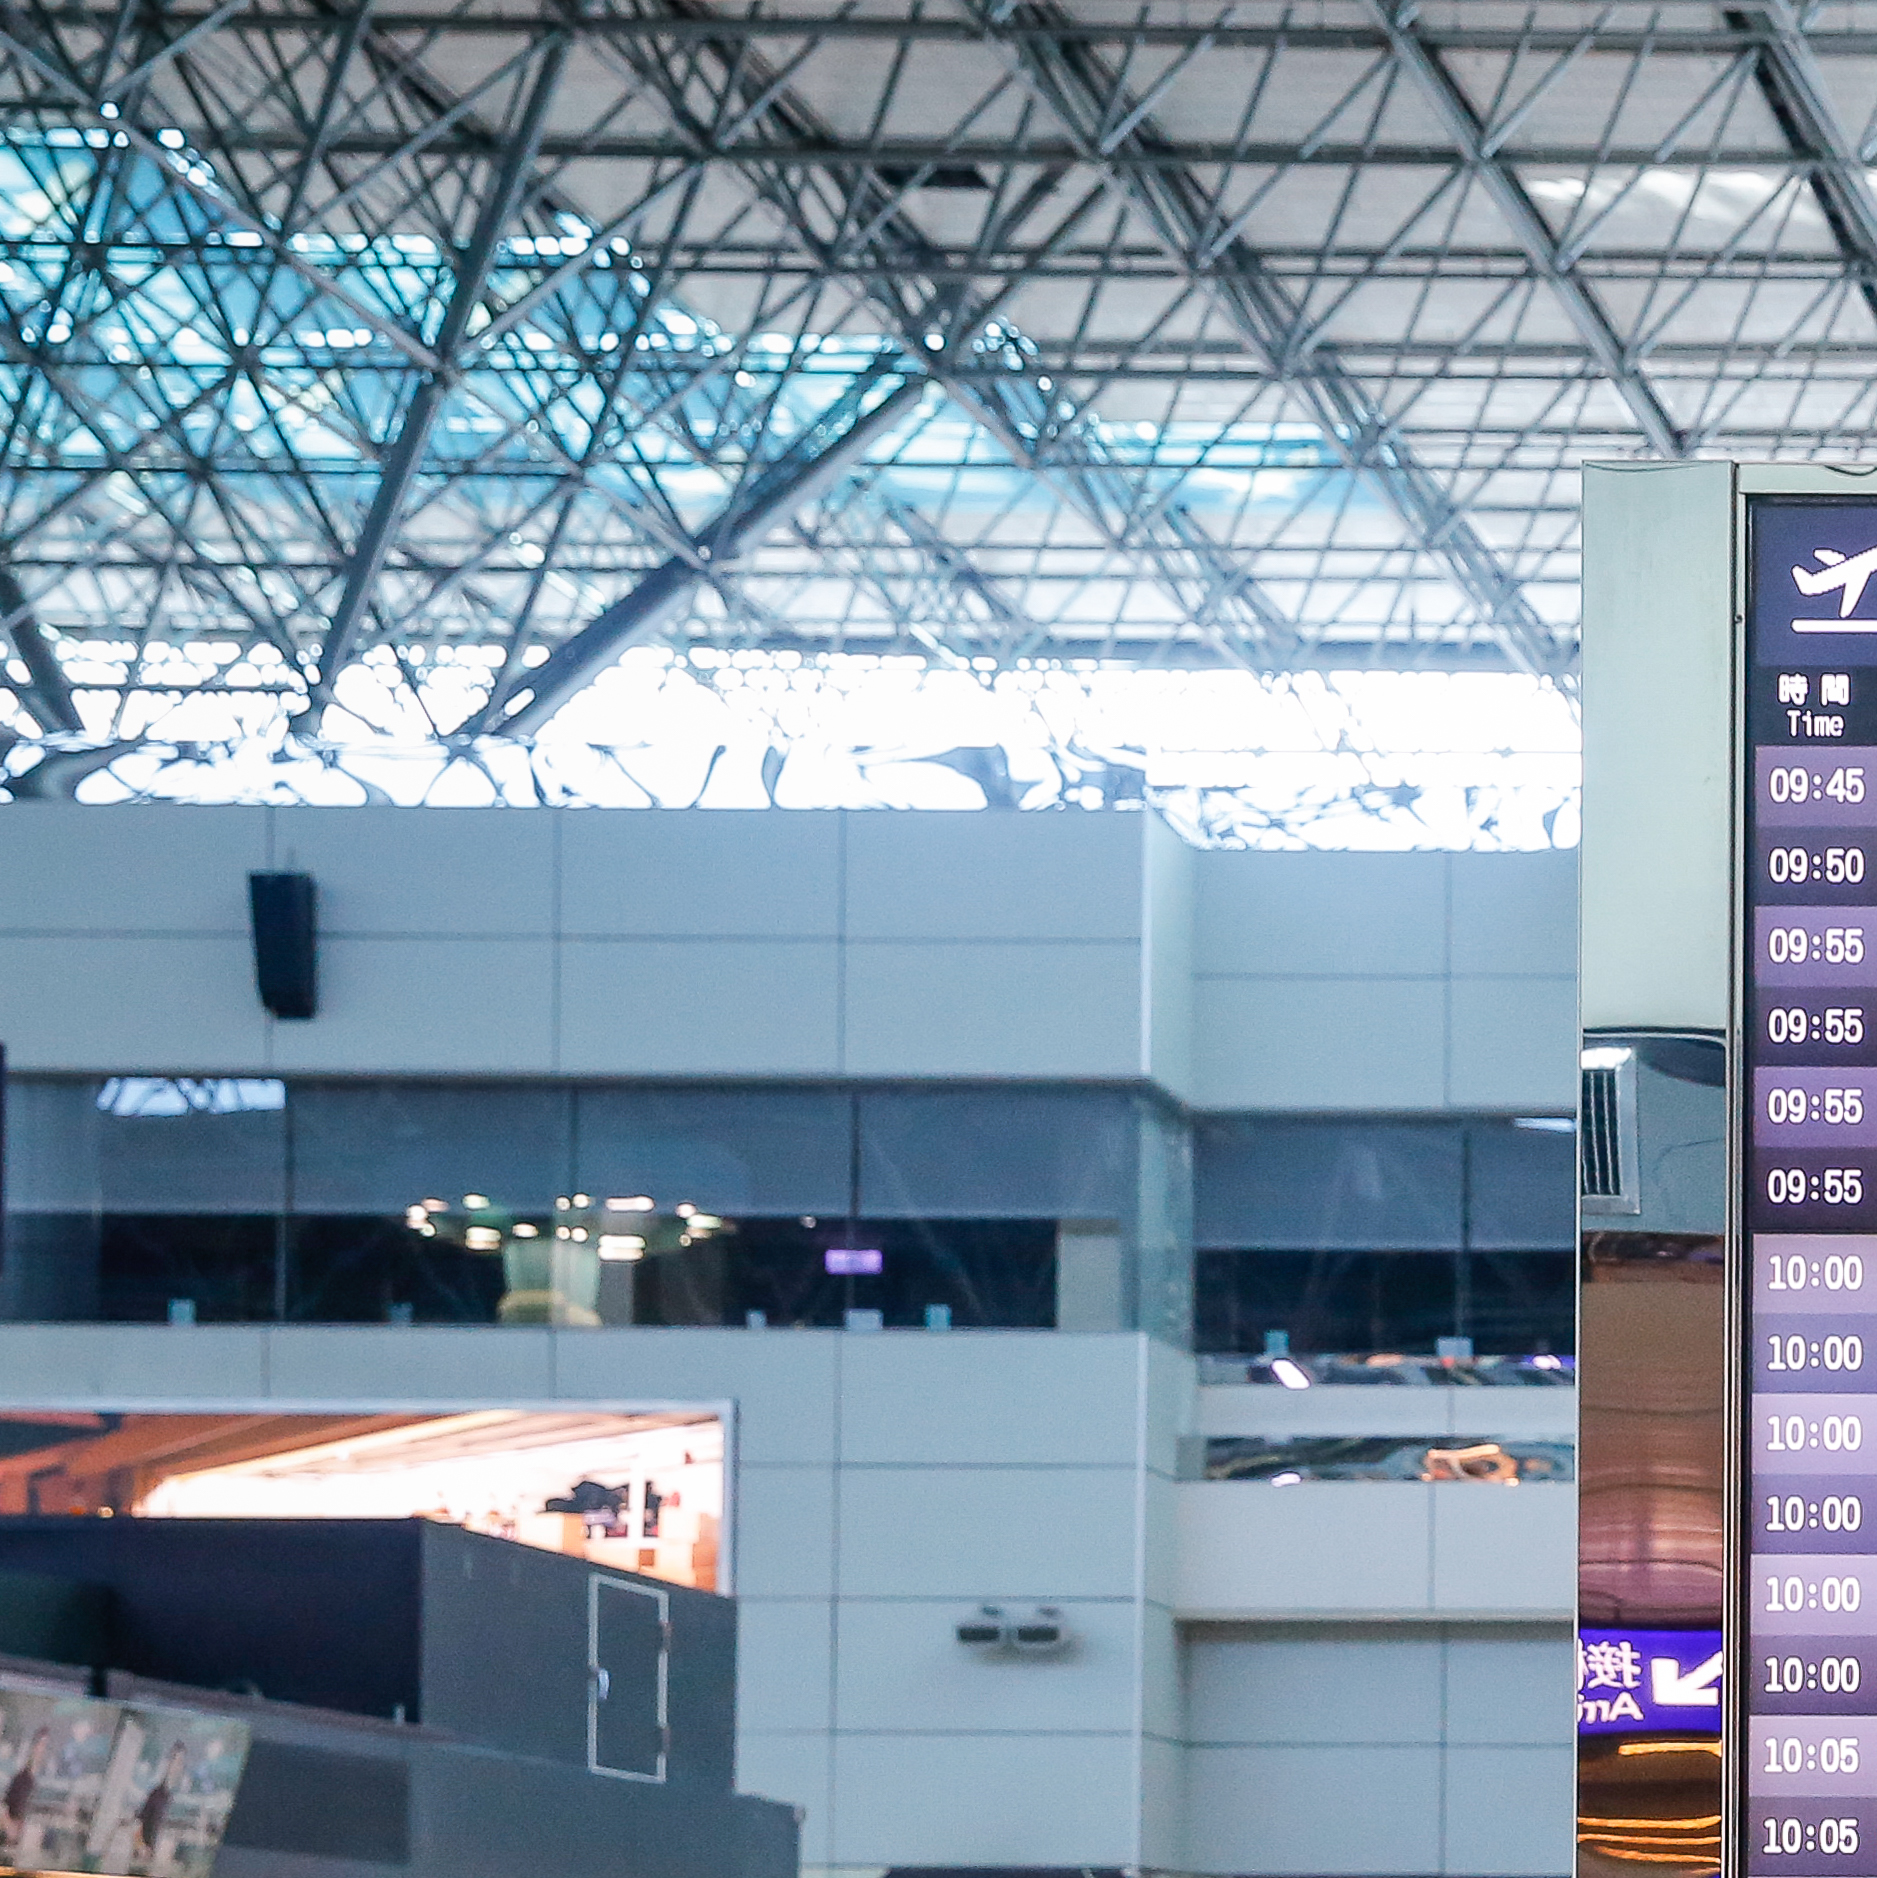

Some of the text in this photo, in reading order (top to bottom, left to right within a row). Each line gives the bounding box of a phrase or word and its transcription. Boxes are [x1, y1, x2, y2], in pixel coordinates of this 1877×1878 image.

[1787, 710, 1844, 738] Time
[1770, 768, 1864, 802] 09:45
[1770, 849, 1864, 882] 09:50
[1769, 929, 1864, 963] 09:55
[1769, 1009, 1863, 1043] 09:55
[1768, 1089, 1863, 1123] 09:55
[1768, 1170, 1862, 1203] 09:55
[1768, 1255, 1863, 1290] 10:00
[1768, 1336, 1862, 1370] 10:00
[1767, 1416, 1862, 1451] 10:00
[1766, 1496, 1861, 1531] 10:00
[1766, 1577, 1860, 1612] 10:00
[1765, 1658, 1860, 1692] 10:00
[1764, 1738, 1859, 1773] 10:05
[1764, 1819, 1858, 1853] 10:05
